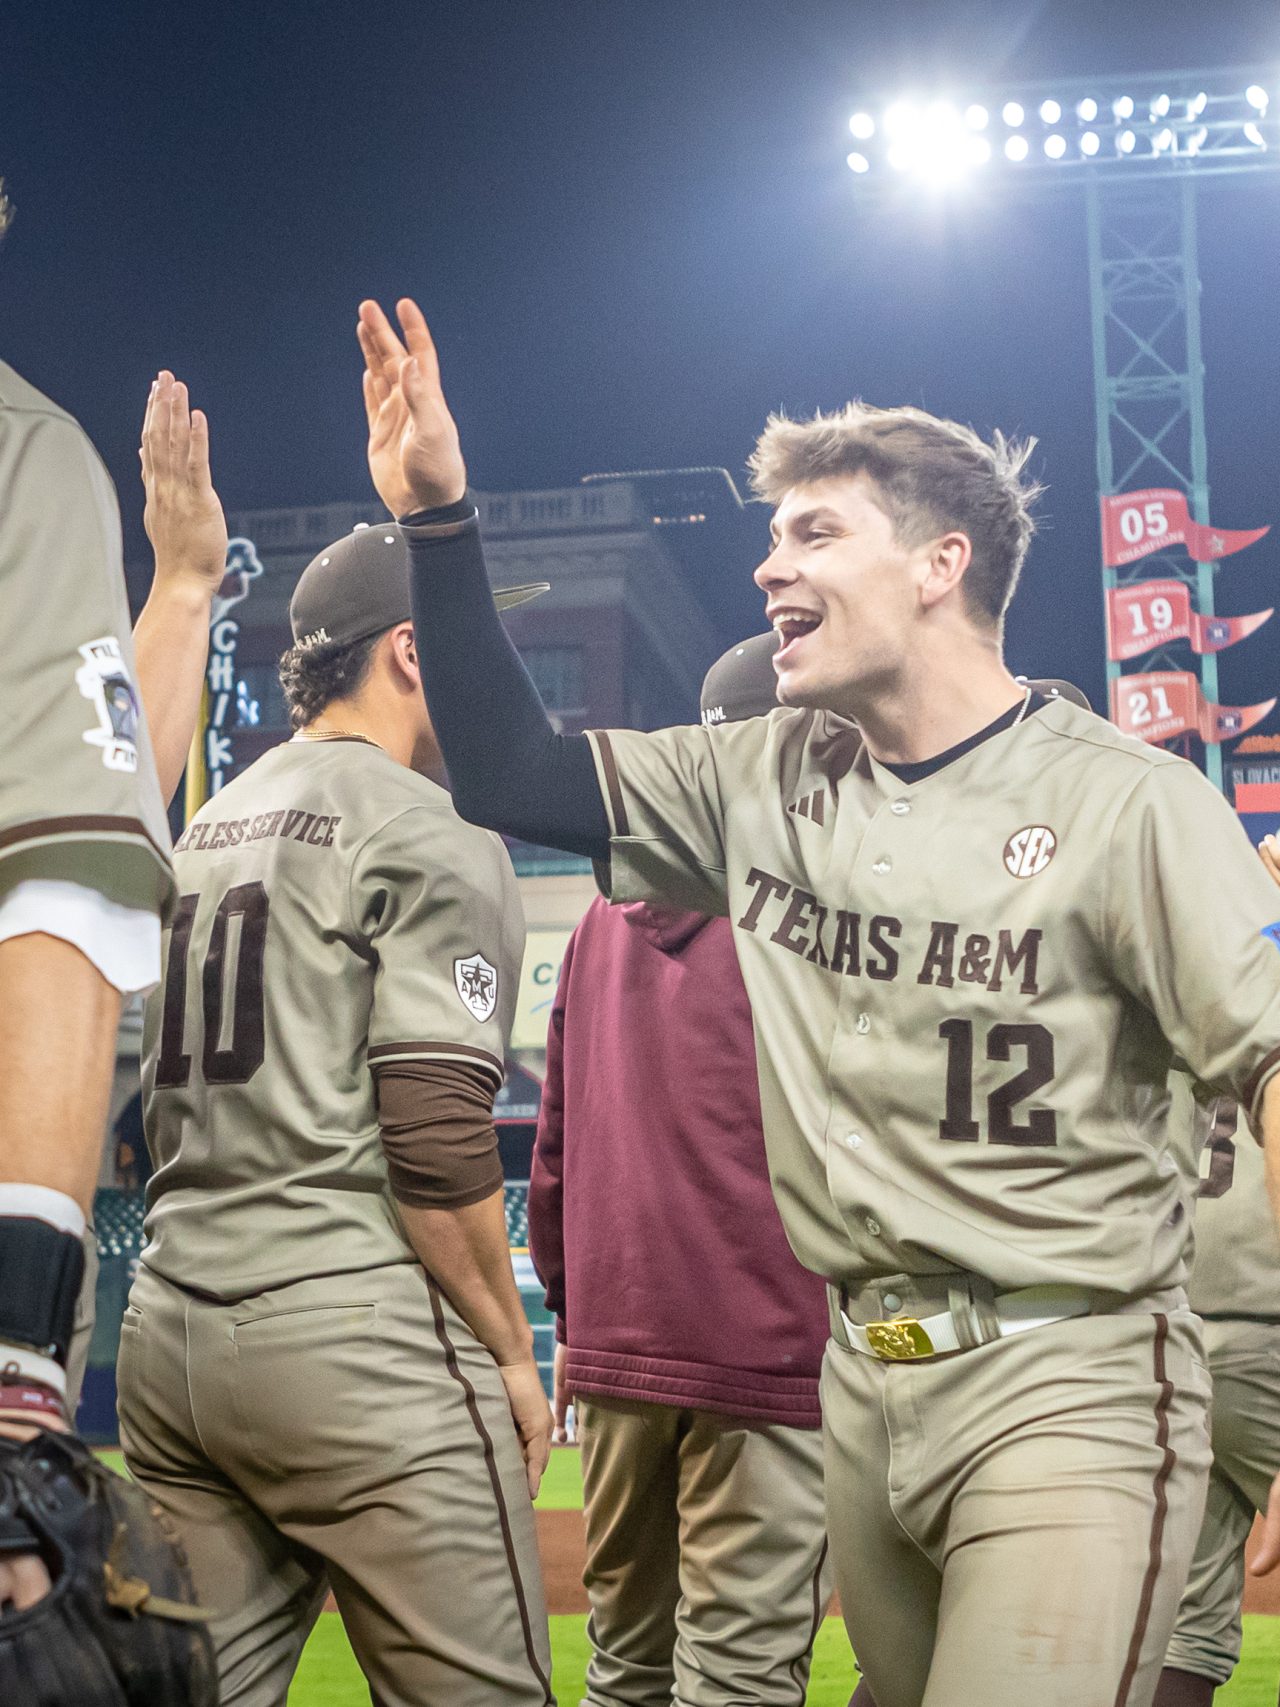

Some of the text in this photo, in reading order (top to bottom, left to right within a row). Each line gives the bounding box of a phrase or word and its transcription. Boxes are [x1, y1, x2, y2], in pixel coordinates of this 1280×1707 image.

[1121, 501, 1168, 543] 05
[1128, 597, 1173, 636] 19
[1128, 687, 1173, 726] 21
[245, 808, 341, 847] SERVICE
[1004, 826, 1056, 877] SEC
[738, 867, 1043, 994] TEXAS A&M
[155, 880, 269, 1089] 10
[938, 1018, 1058, 1147] 12
